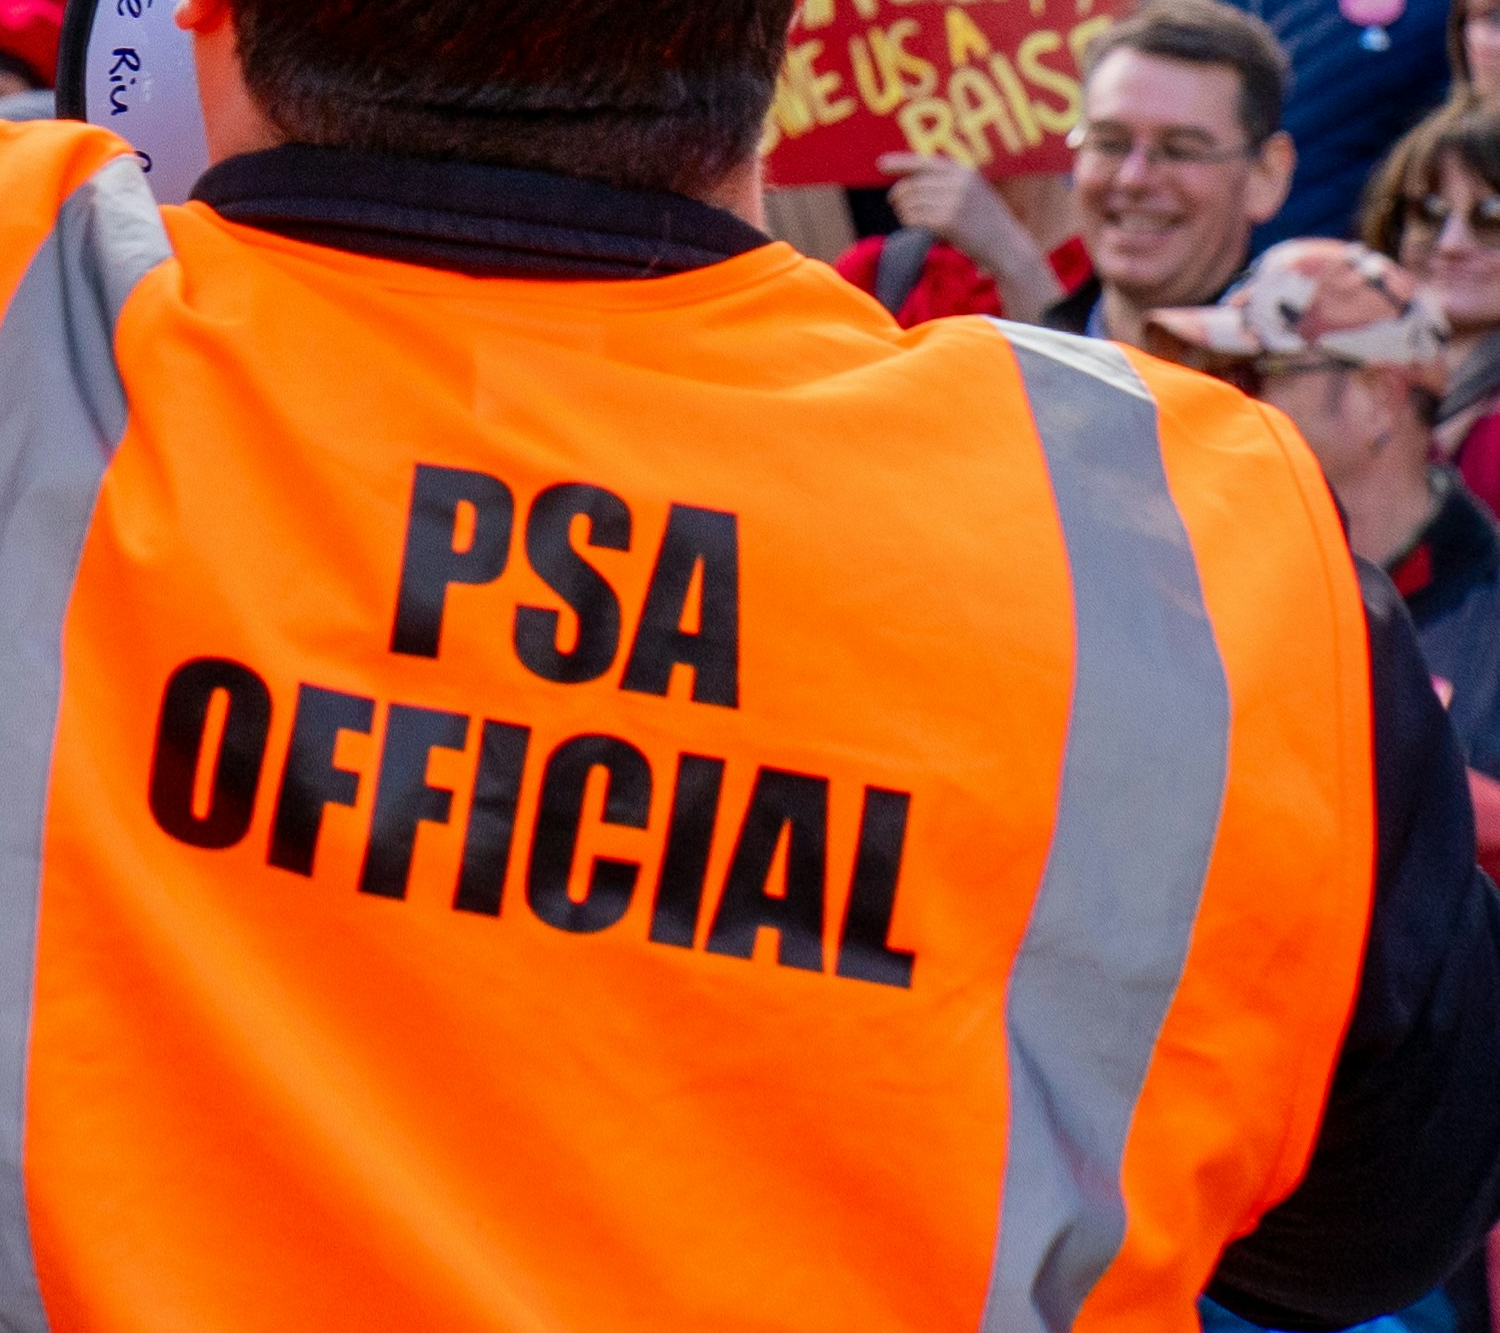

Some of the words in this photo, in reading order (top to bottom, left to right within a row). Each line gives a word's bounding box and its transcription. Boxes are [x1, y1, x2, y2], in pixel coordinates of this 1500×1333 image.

[849, 19, 940, 117] US
[390, 461, 741, 711] PSA
[144, 656, 917, 990] OFFICIAL
